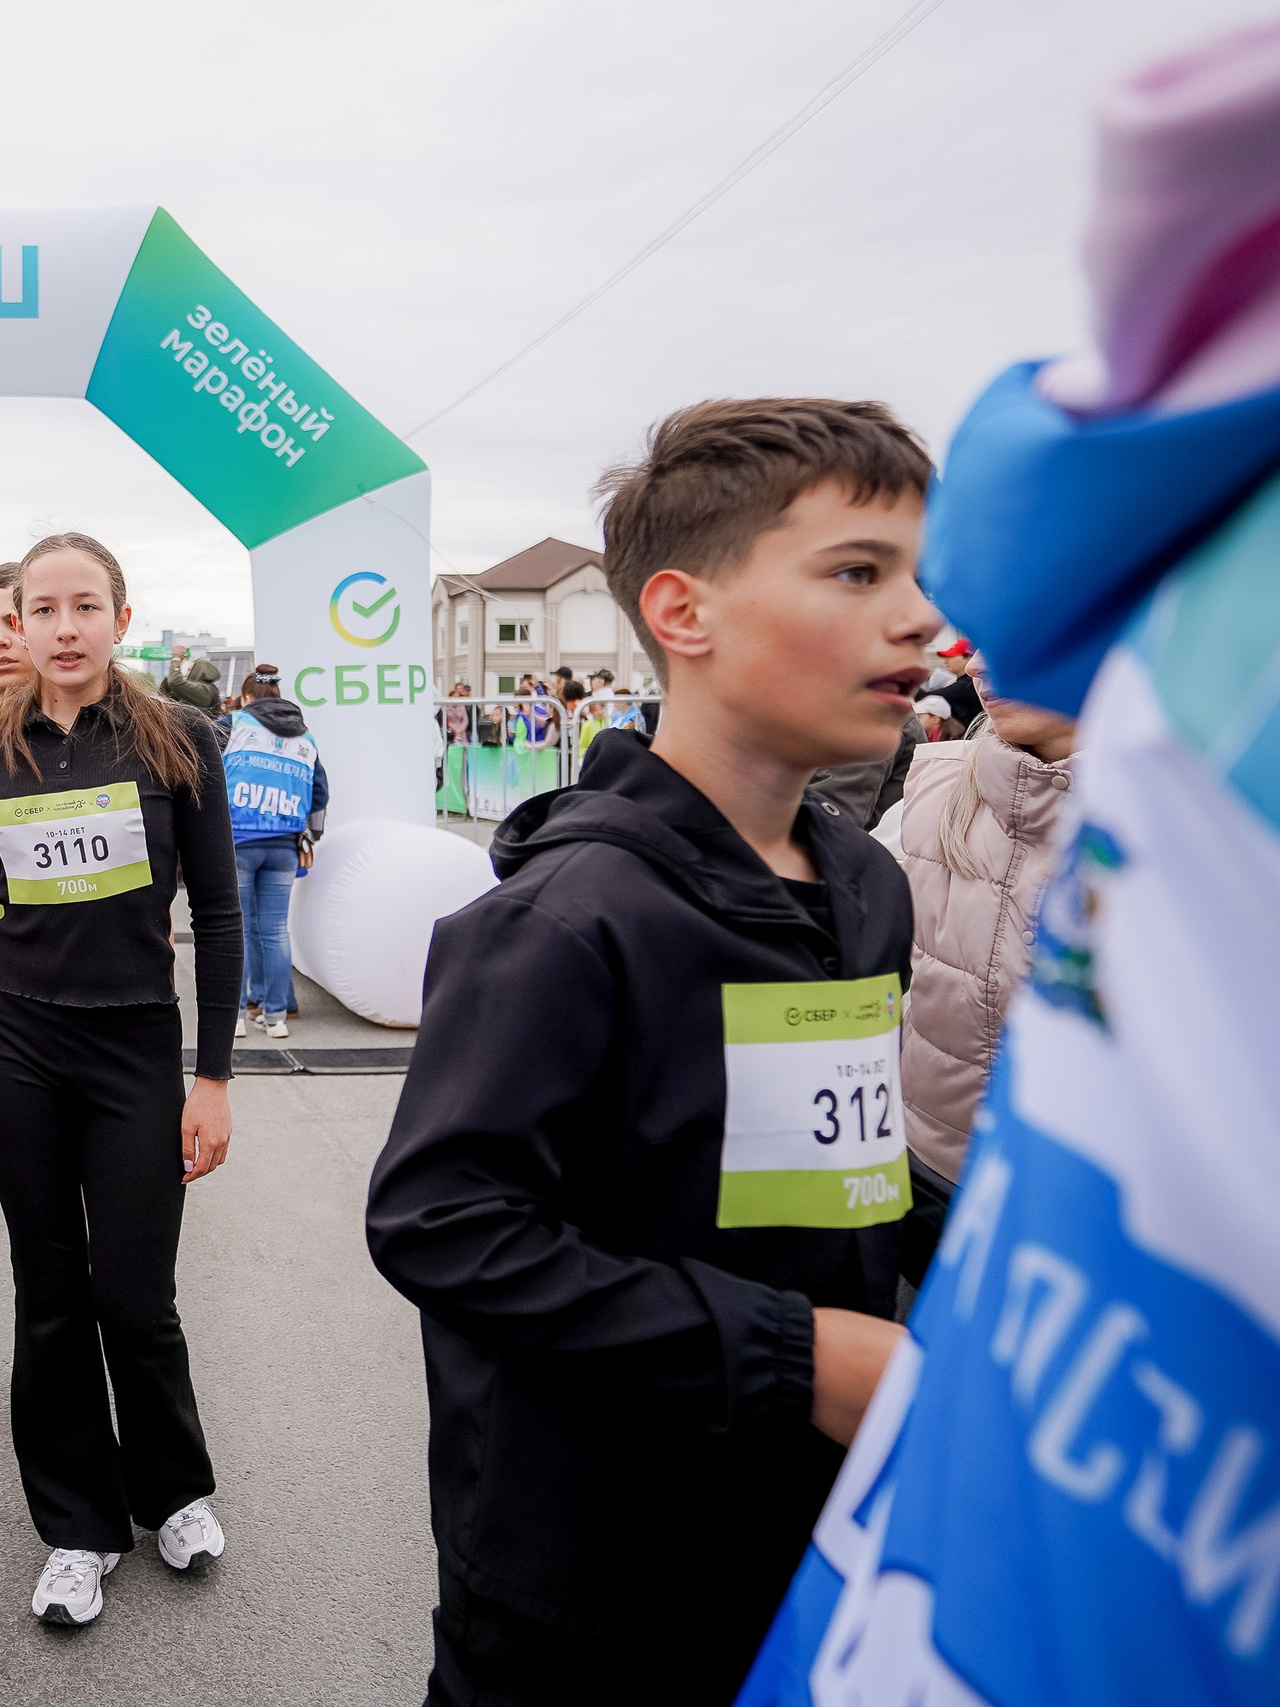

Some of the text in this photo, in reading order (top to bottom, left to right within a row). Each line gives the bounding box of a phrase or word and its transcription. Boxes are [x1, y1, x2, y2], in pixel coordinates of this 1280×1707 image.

[185, 303, 336, 443] зелёный
[160, 327, 307, 468] марафон
[294, 663, 427, 708] СБЕР
[24, 806, 44, 815] СБЕР
[232, 781, 301, 817] СУДЬЯ
[45, 826, 86, 838] 10-14 ЛЕТ
[33, 835, 109, 869] 3110
[804, 1009, 838, 1022] СБЕР
[813, 1082, 892, 1145] 312
